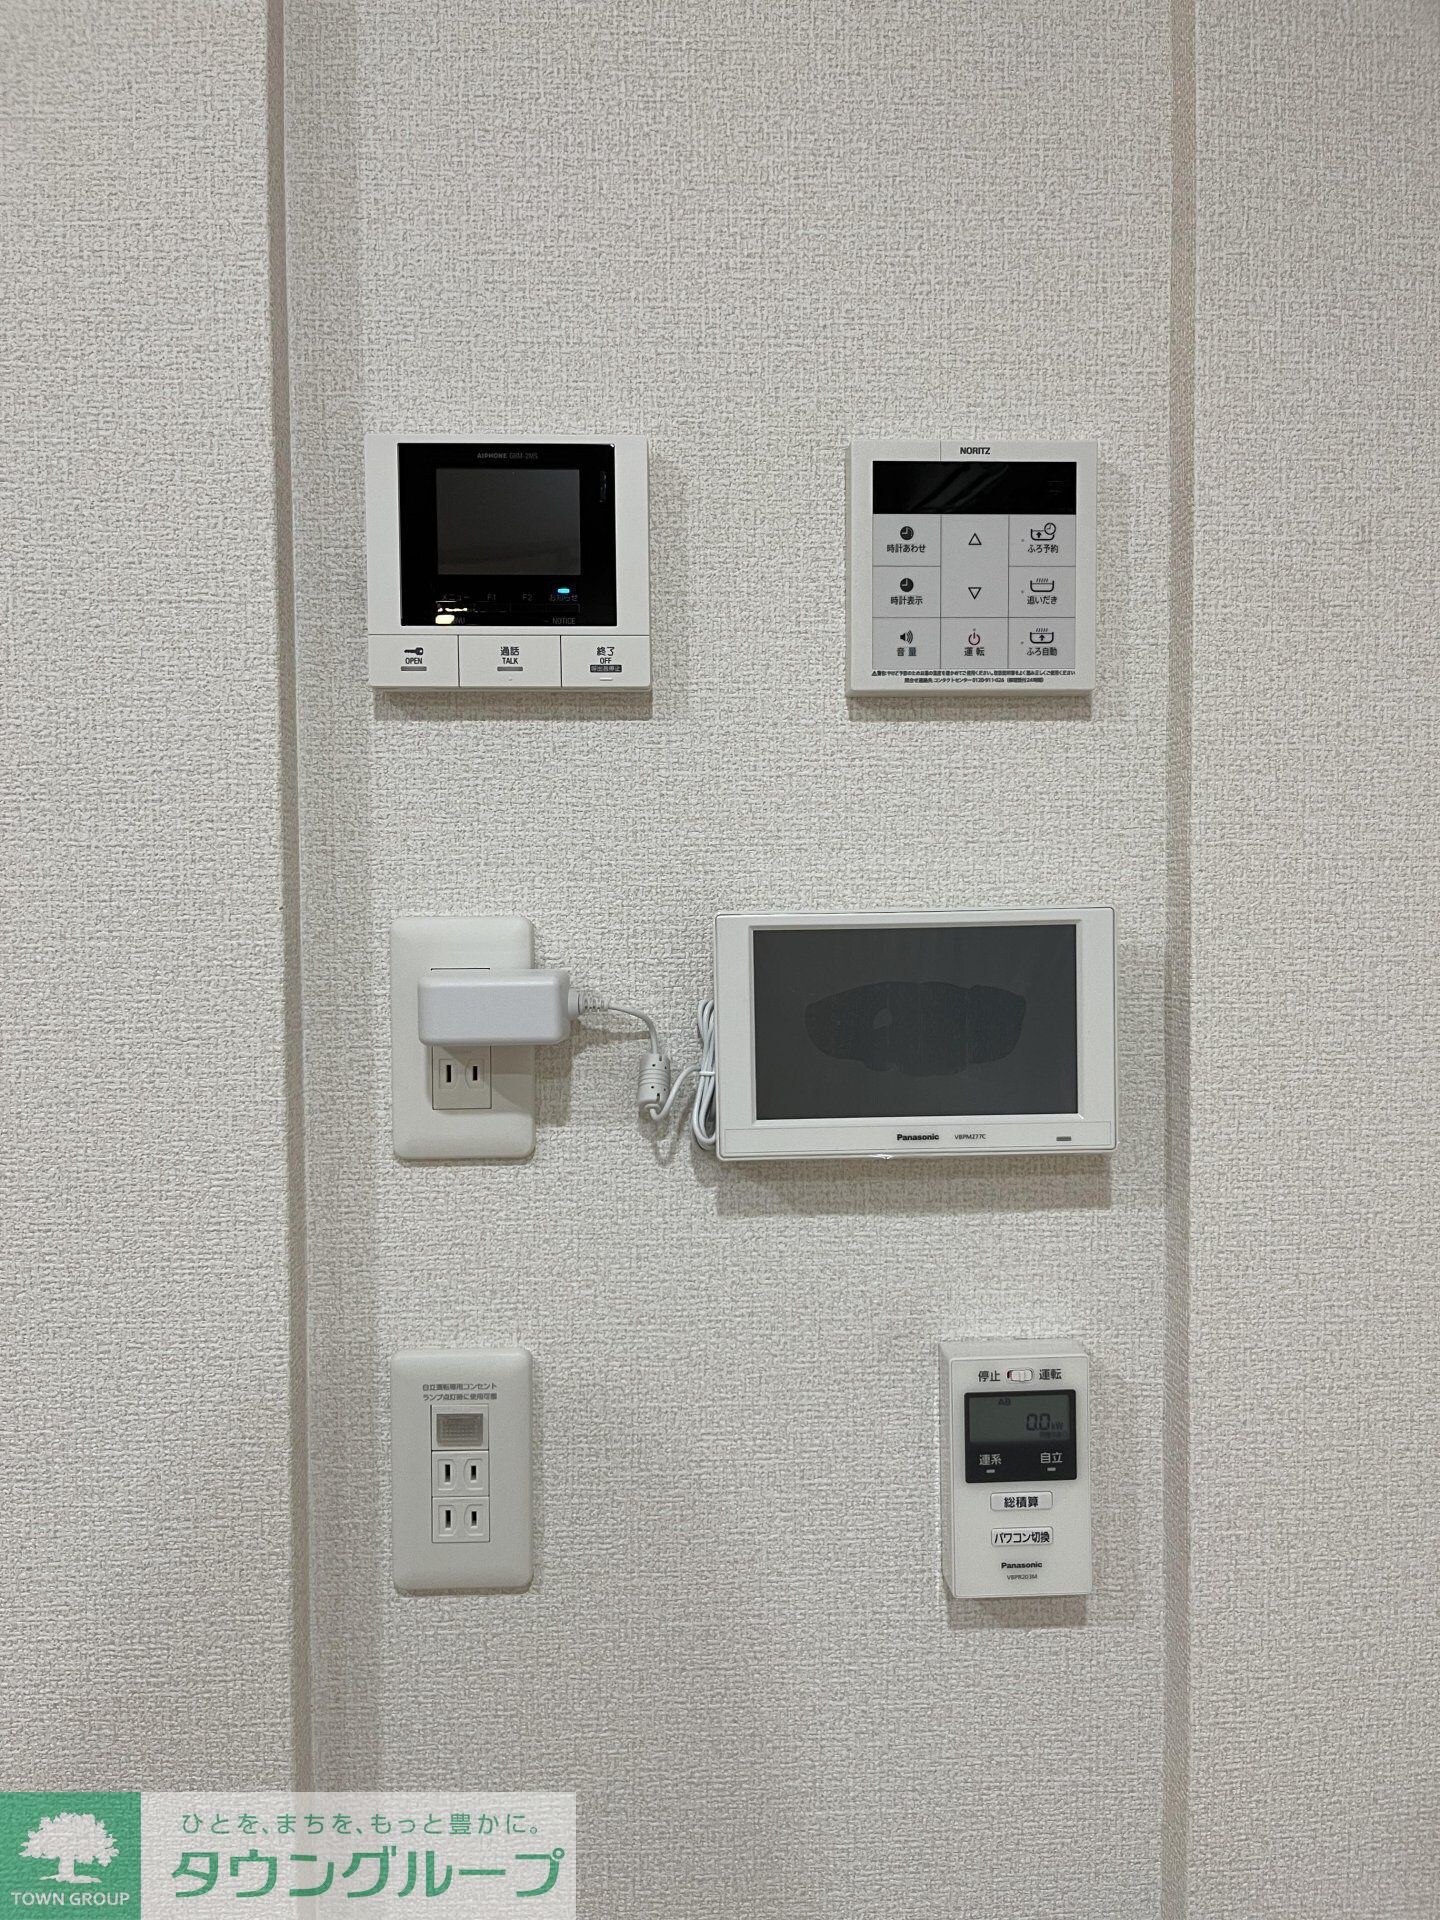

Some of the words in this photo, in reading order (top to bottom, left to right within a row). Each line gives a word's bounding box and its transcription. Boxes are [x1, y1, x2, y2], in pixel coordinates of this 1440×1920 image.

[960, 446, 991, 455] NORITZ
[477, 452, 508, 460] AIPHONE
[886, 543, 926, 553] 時計あわせ
[1027, 543, 1059, 554] ふろ予約
[890, 595, 923, 606] 時計表示
[1026, 595, 1058, 605] 追いだき
[552, 617, 576, 625] NOTICE
[500, 646, 520, 656] 通話
[596, 646, 615, 656] 終了
[896, 647, 917, 657] 音量
[964, 647, 985, 657] 運転
[1026, 647, 1058, 657] ふろ自動
[405, 657, 423, 665] OPEN
[502, 657, 518, 665] TALK
[599, 657, 612, 665] OFF
[897, 1133, 939, 1141] Panasonic
[978, 1370, 1001, 1382] 停止
[1038, 1368, 1062, 1380] 運転
[1040, 1451, 1063, 1464] 自立
[1003, 1496, 1039, 1508] 総積算
[994, 1531, 1050, 1544] パワコン切換
[1001, 1561, 1043, 1569] Panasonic
